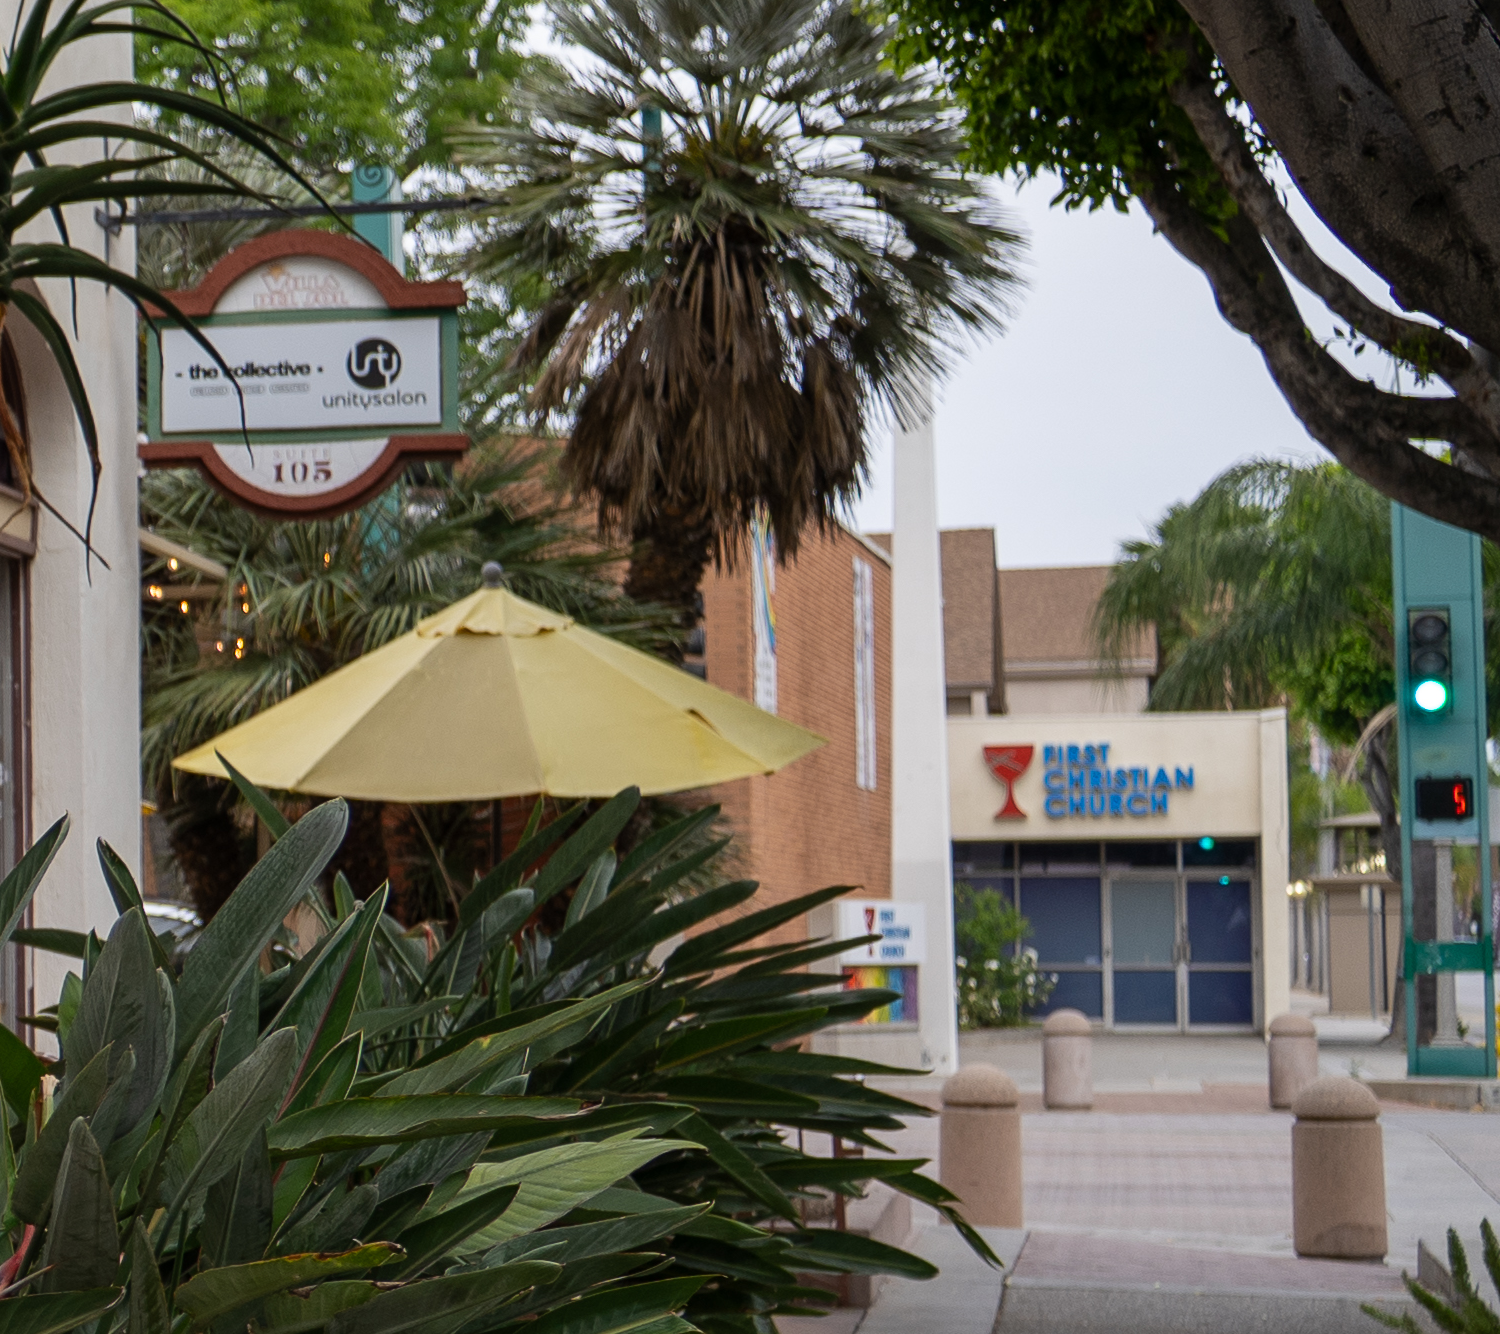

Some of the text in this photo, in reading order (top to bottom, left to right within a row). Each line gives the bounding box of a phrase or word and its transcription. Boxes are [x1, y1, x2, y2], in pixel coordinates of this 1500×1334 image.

[189, 363, 218, 379] the
[322, 389, 427, 411] unitysalon
[273, 460, 332, 483] 105
[1043, 744, 1110, 765] FIRST
[1043, 766, 1194, 790] CHRISTIAN
[1043, 791, 1169, 817] CHURCH
